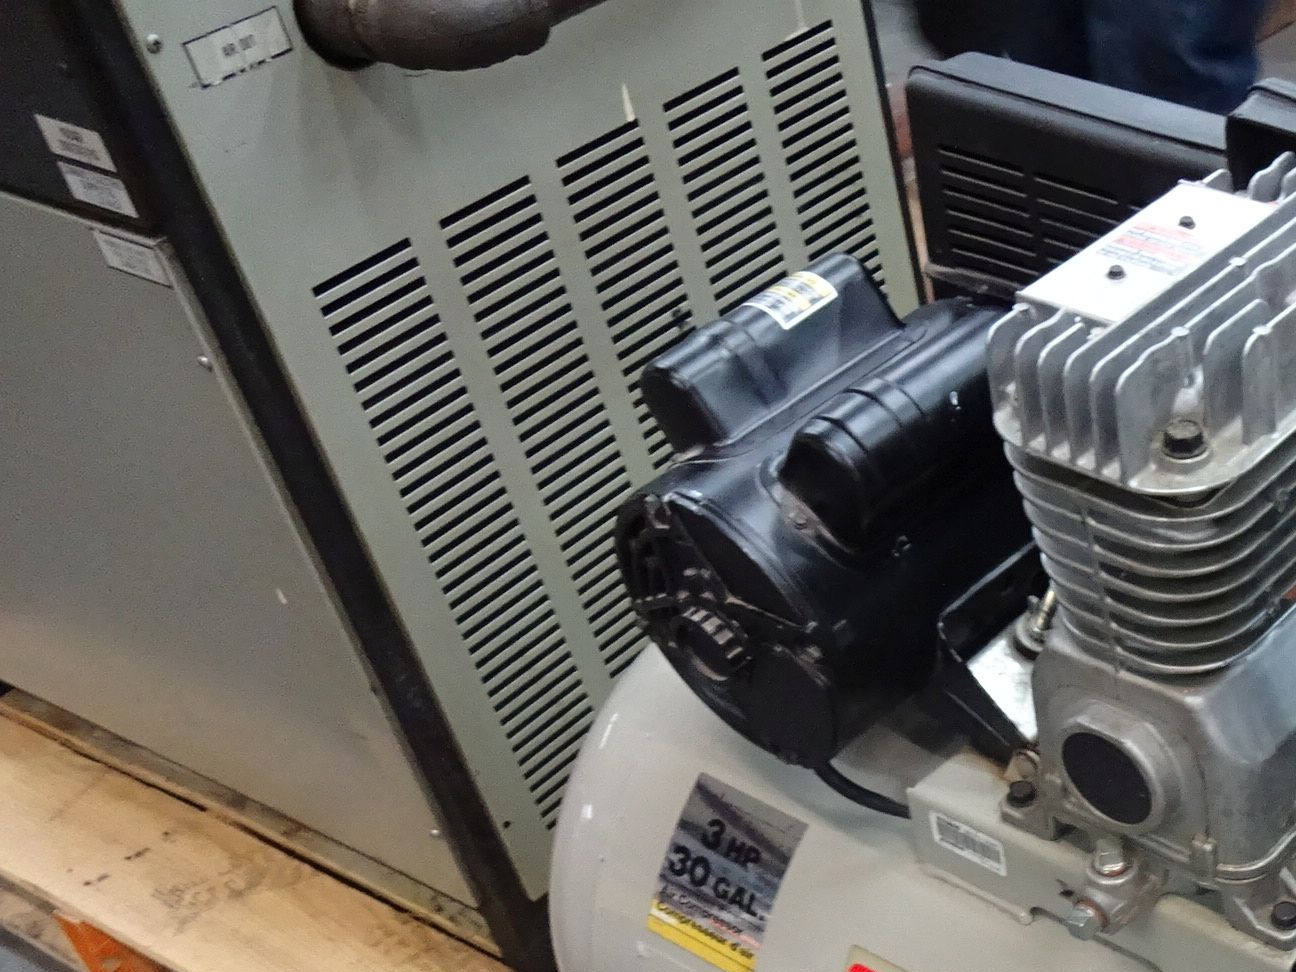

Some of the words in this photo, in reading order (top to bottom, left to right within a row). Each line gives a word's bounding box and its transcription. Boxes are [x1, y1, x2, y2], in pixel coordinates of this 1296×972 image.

[702, 818, 726, 850] 3
[668, 845, 711, 888] 30
[713, 876, 766, 921] GAL.
